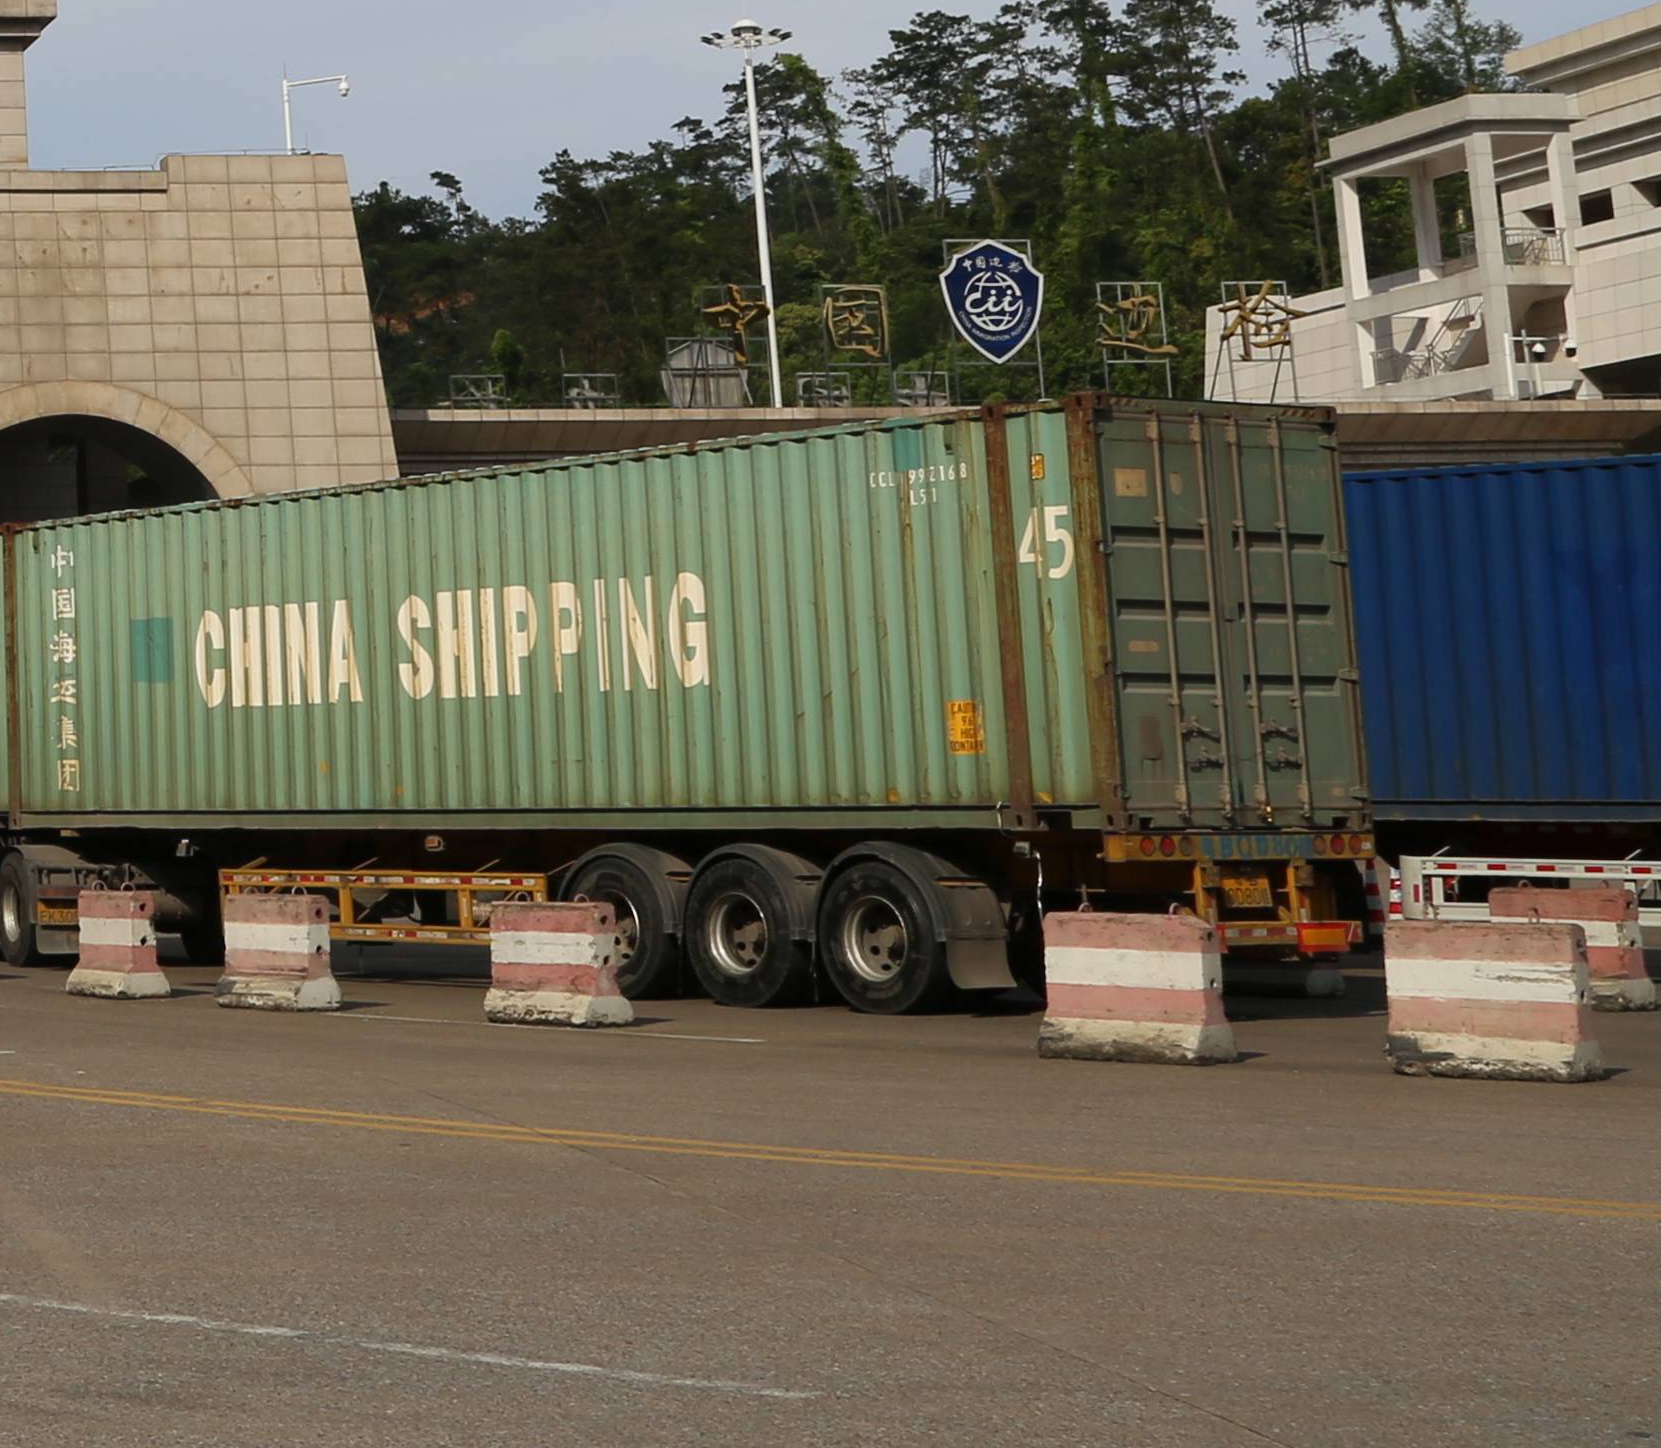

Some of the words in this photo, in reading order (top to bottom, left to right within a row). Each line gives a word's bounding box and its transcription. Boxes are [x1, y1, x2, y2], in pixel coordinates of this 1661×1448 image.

[962, 256, 1024, 273] 中国边检
[1018, 504, 1076, 580] 45
[50, 544, 82, 793] 中国海运集团
[194, 597, 364, 709] CHINA
[398, 570, 711, 700] SHIPPING
